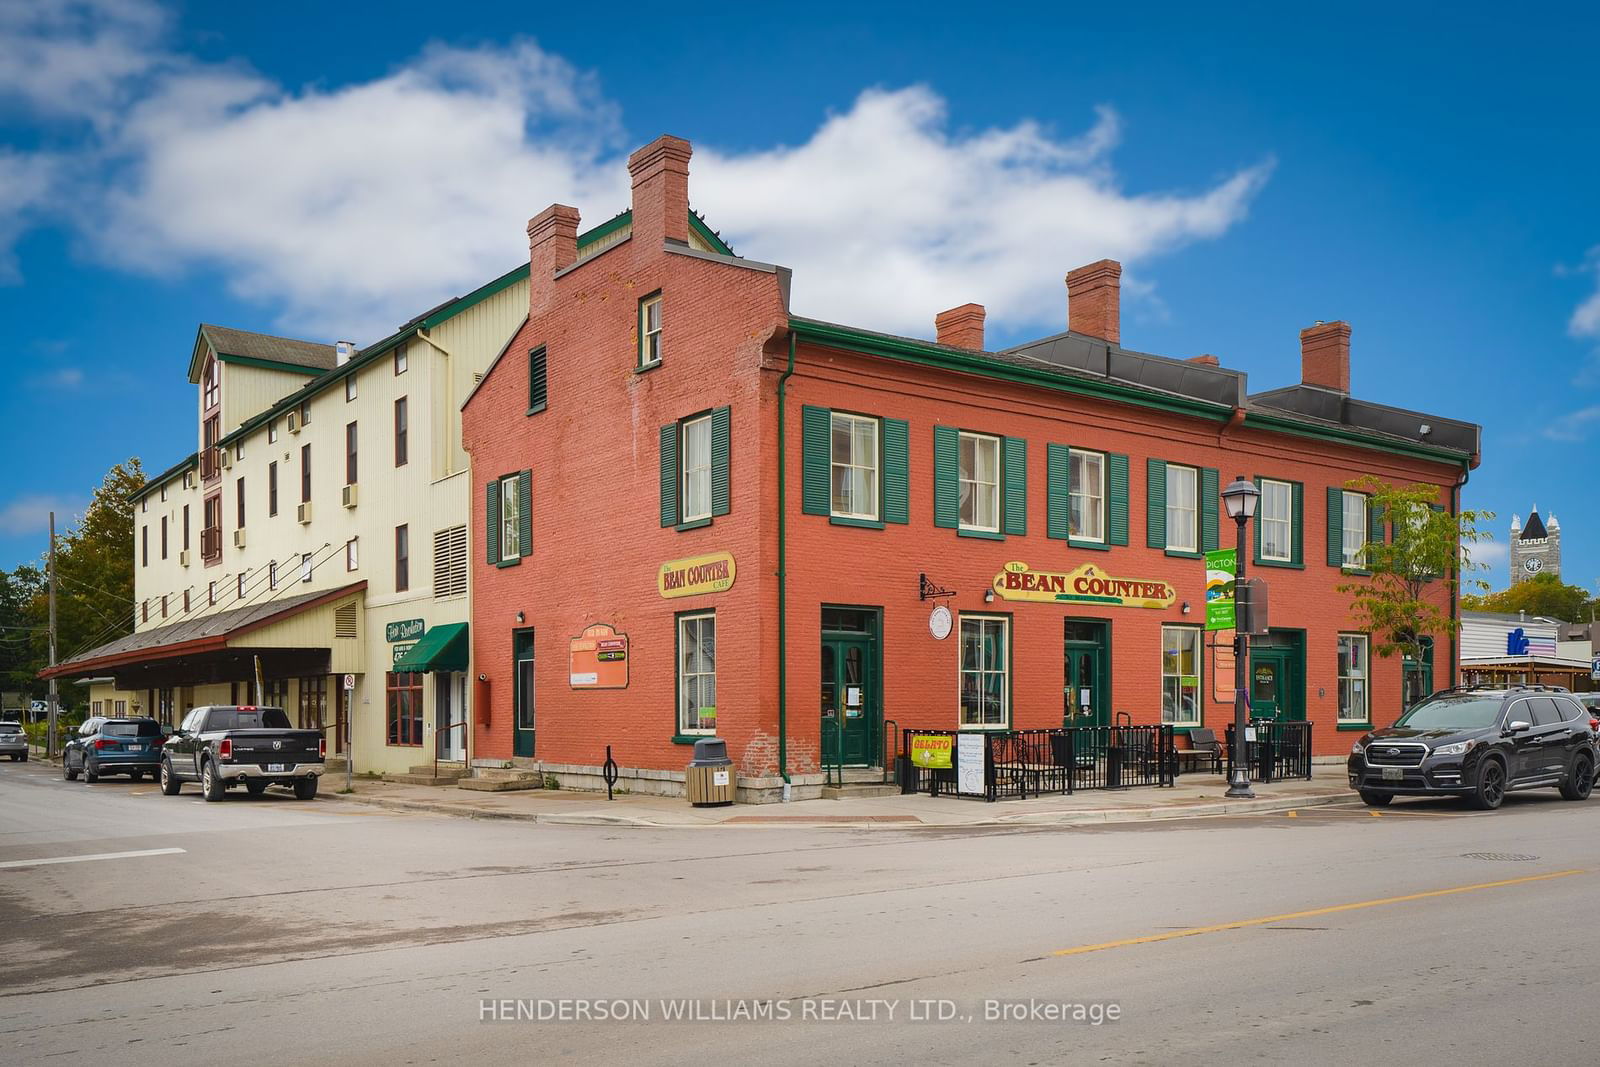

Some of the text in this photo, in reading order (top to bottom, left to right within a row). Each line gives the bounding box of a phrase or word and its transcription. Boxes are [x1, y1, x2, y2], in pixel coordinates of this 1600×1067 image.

[1011, 563, 1024, 571] The
[1206, 559, 1236, 568] PICTON
[664, 560, 729, 590] BEAN COUNTER
[1005, 573, 1168, 600] BEAN COUNTER
[914, 740, 949, 750] GELATO
